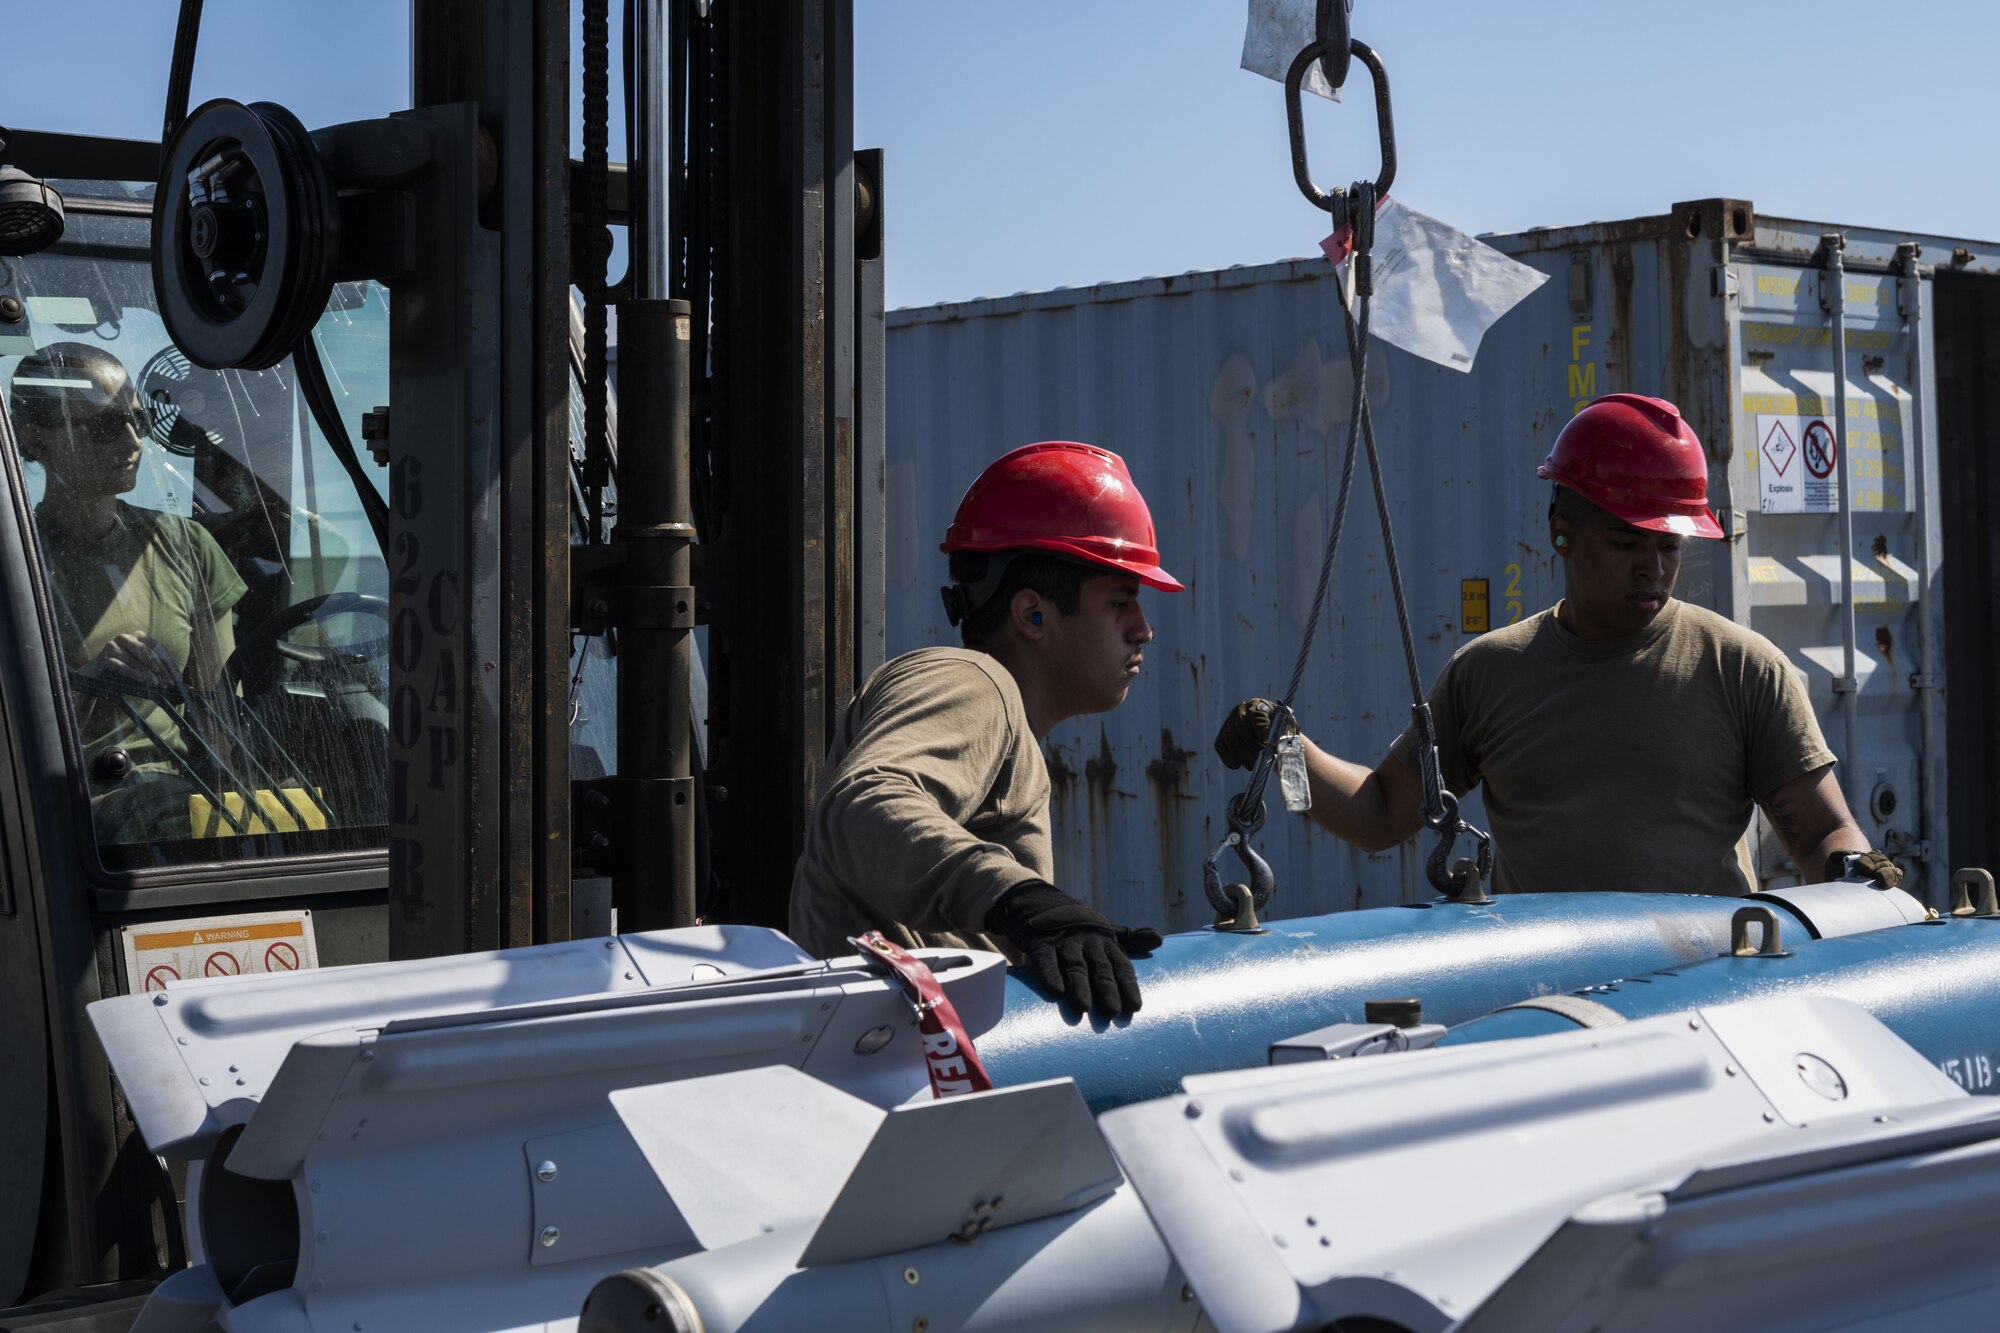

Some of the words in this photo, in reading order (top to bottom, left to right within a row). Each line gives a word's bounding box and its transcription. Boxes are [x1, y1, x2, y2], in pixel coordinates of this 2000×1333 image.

[1744, 323, 1800, 343] TRANSP
[1802, 327, 1833, 346] CON
[1743, 396, 1773, 413] MAX
[1777, 398, 1827, 415] GROSS
[1749, 565, 1778, 582] NET
[428, 570, 460, 791] CAP
[205, 930, 250, 941] WARNING
